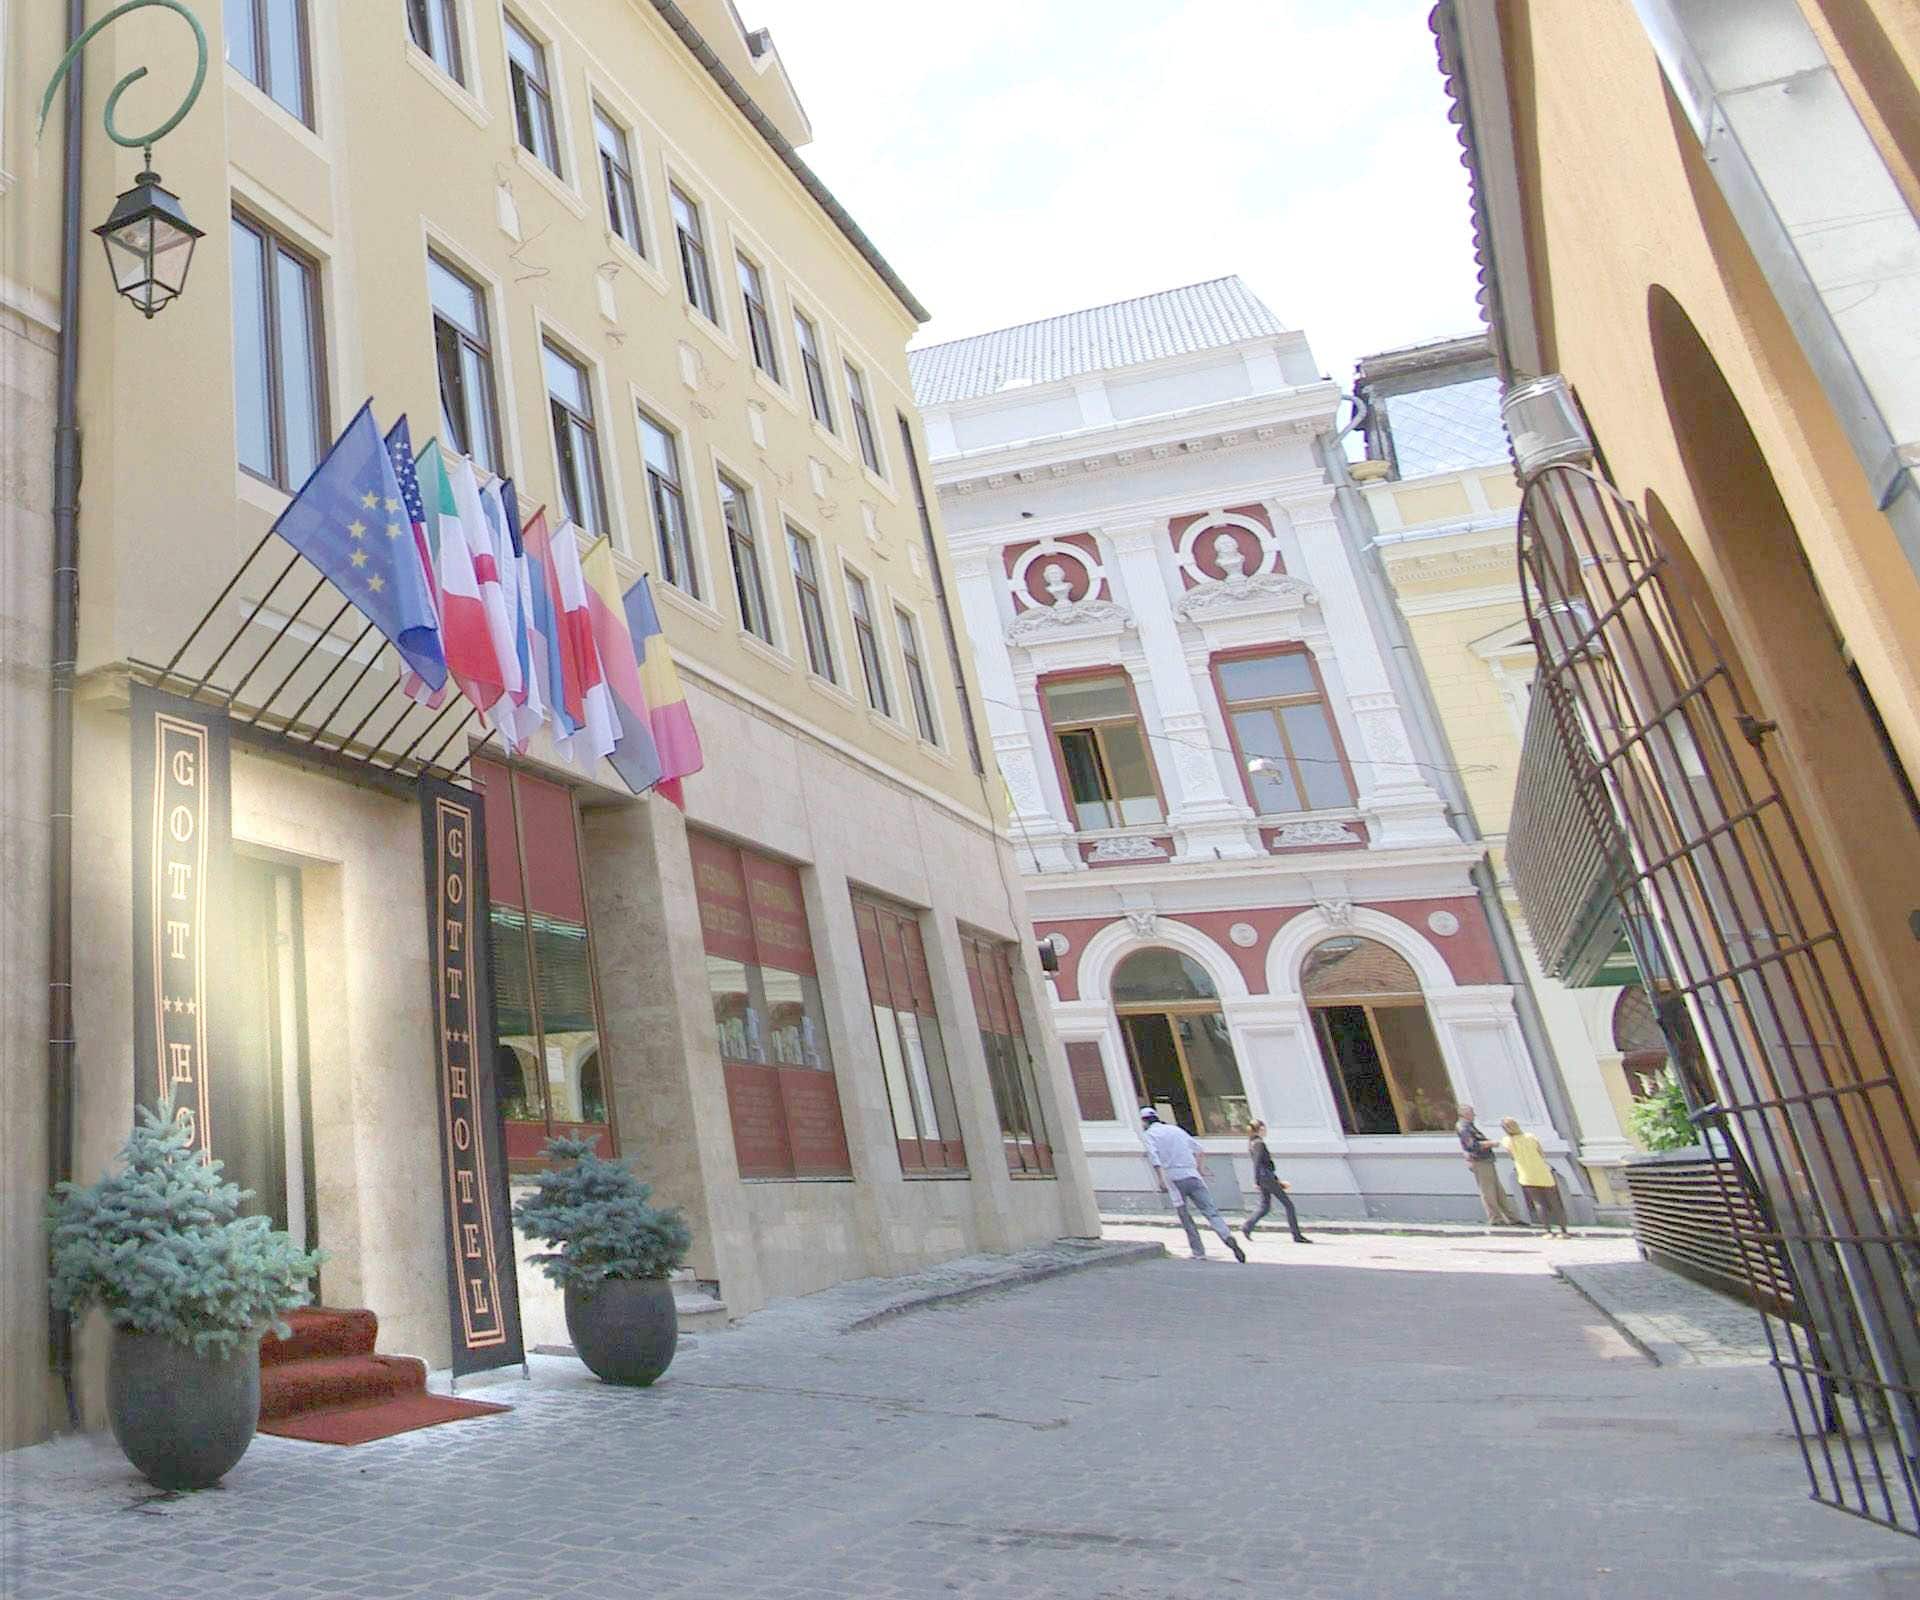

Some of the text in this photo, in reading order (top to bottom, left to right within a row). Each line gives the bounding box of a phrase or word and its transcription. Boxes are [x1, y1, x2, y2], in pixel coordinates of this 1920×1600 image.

[166, 750, 195, 960] GOTT
[447, 829, 489, 1314] GOTT HOTEL
